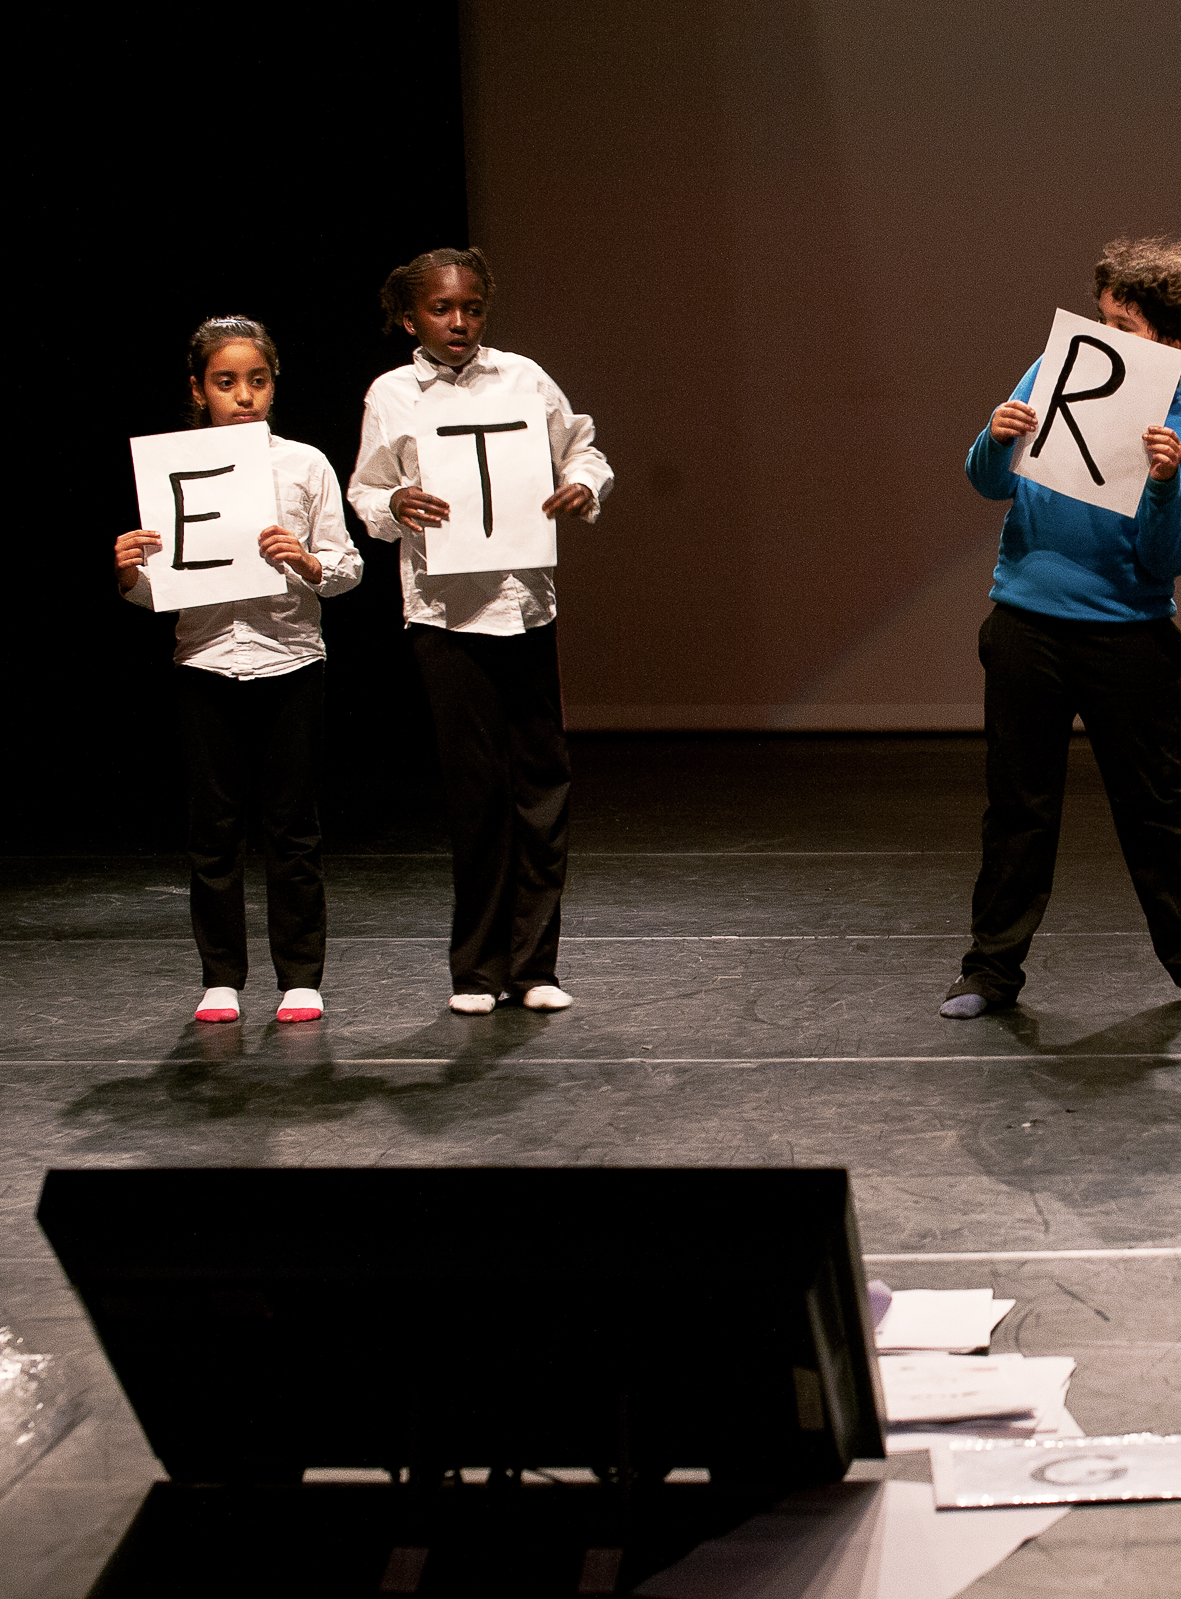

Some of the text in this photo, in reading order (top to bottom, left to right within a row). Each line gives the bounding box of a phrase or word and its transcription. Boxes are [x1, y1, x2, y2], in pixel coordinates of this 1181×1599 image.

[1029, 334, 1126, 487] R
[168, 464, 236, 571] E
[436, 420, 528, 538] T
